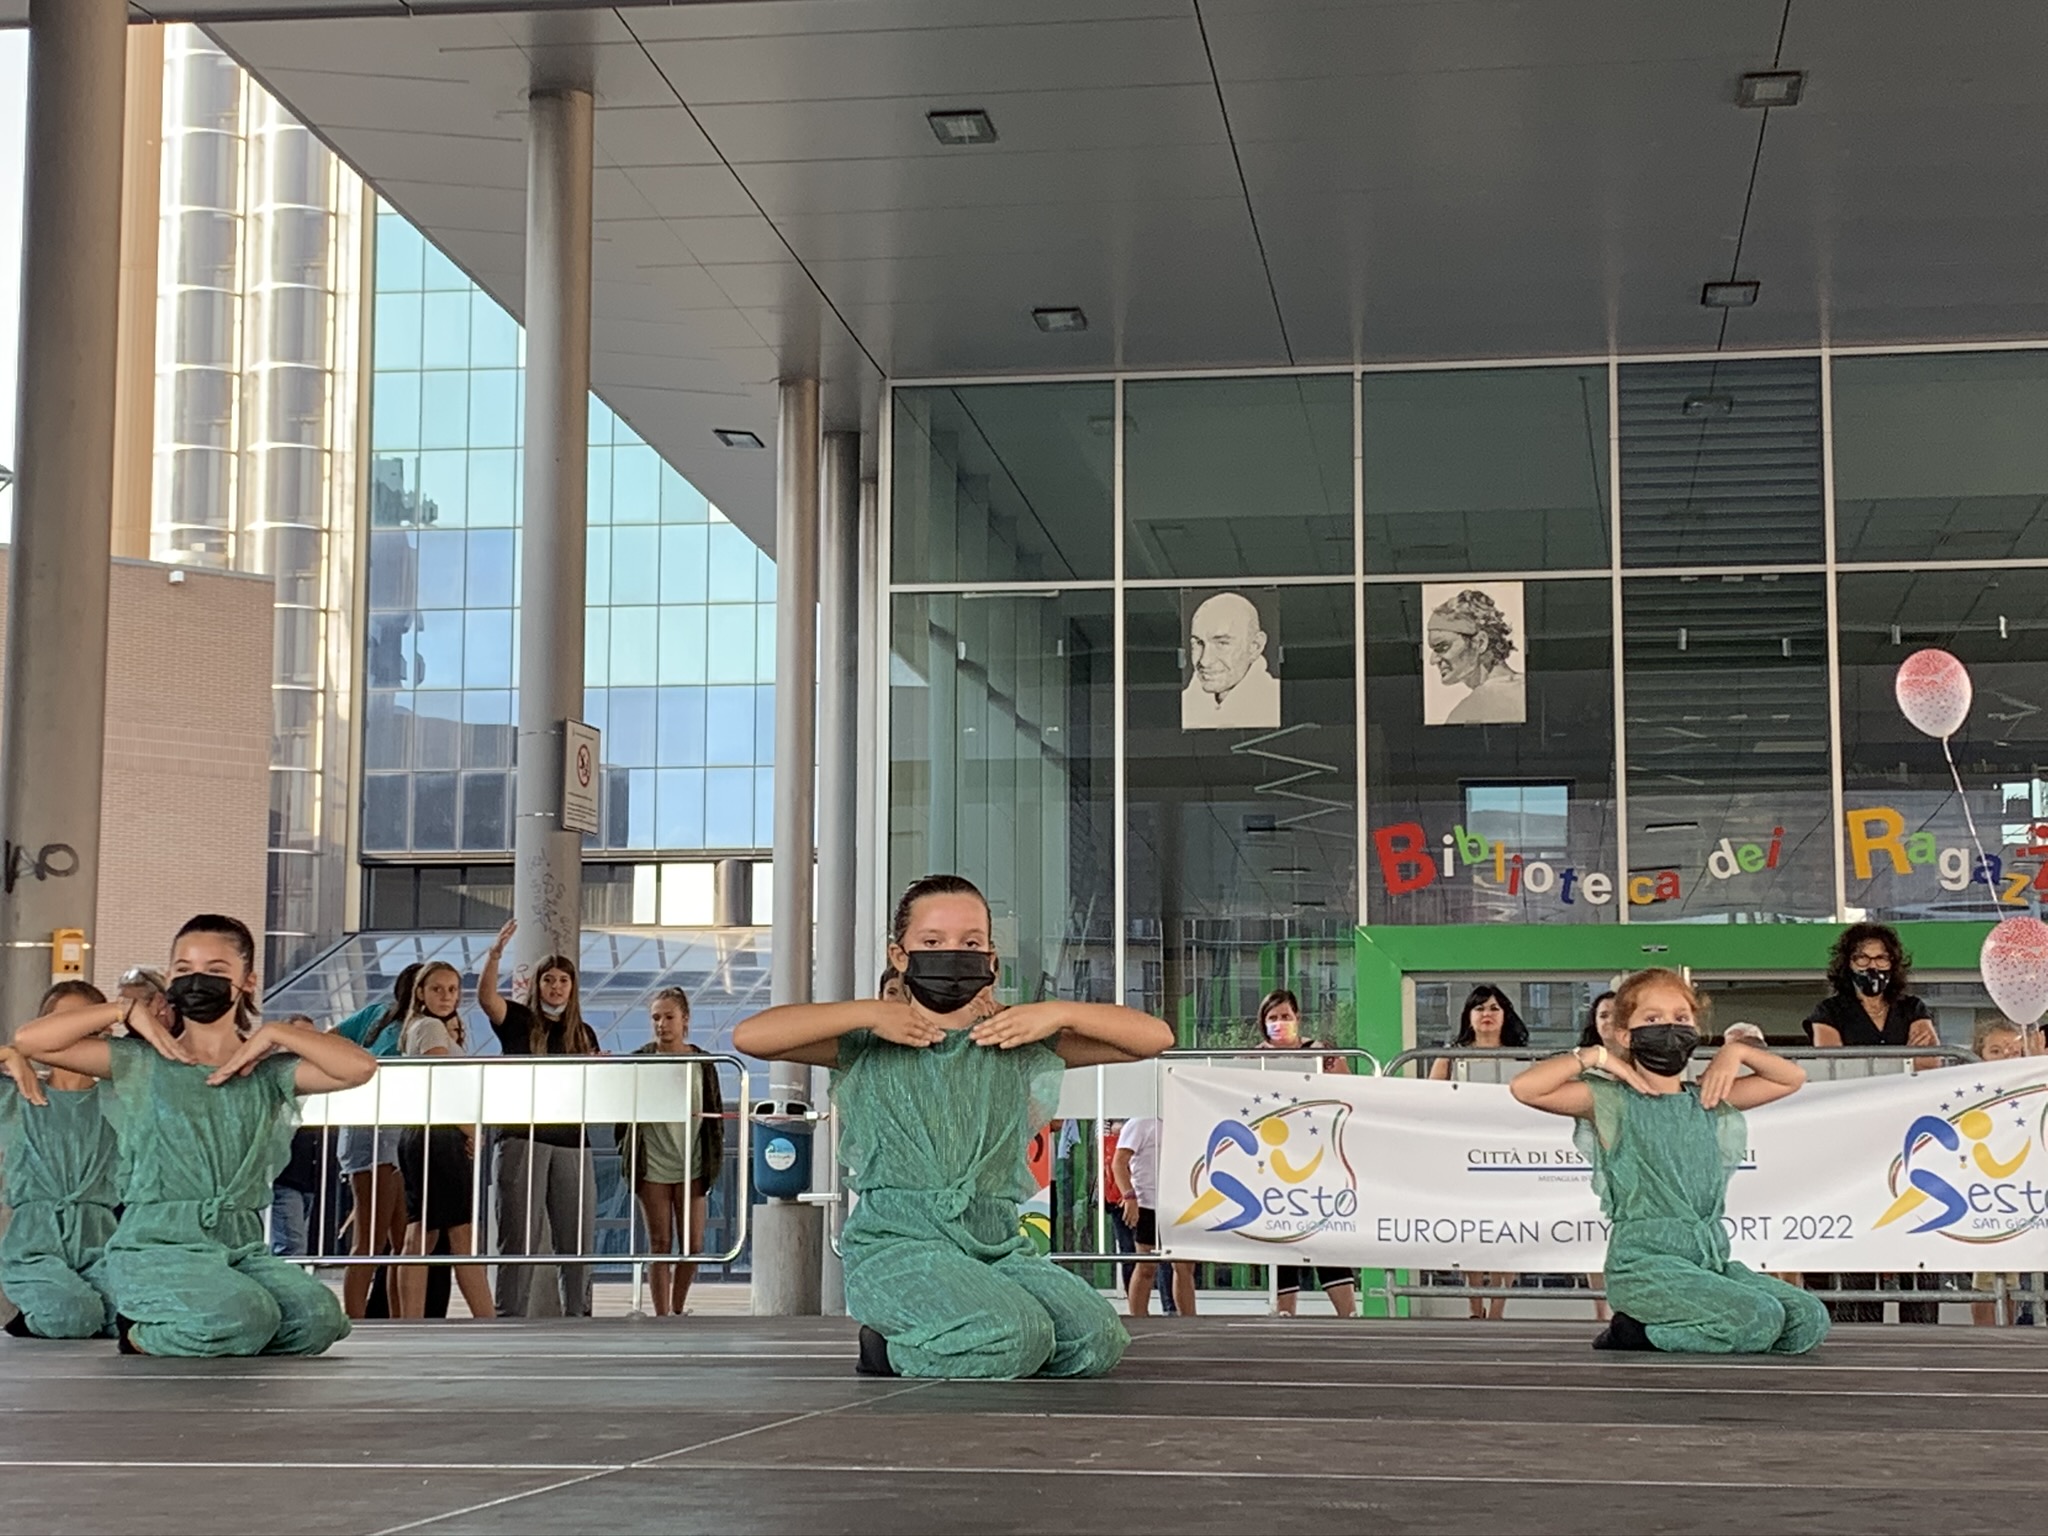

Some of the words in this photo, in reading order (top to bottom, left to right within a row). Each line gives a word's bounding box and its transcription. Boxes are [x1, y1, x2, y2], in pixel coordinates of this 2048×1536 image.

[1374, 822, 1681, 905] Biblioteca
[1708, 826, 1786, 879] dei
[1555, 1149, 1584, 1164] SES
[1377, 1218, 1540, 1243] EUROPEAN
[1551, 1220, 1613, 1243] CITY
[1782, 1214, 1854, 1241] 2022
